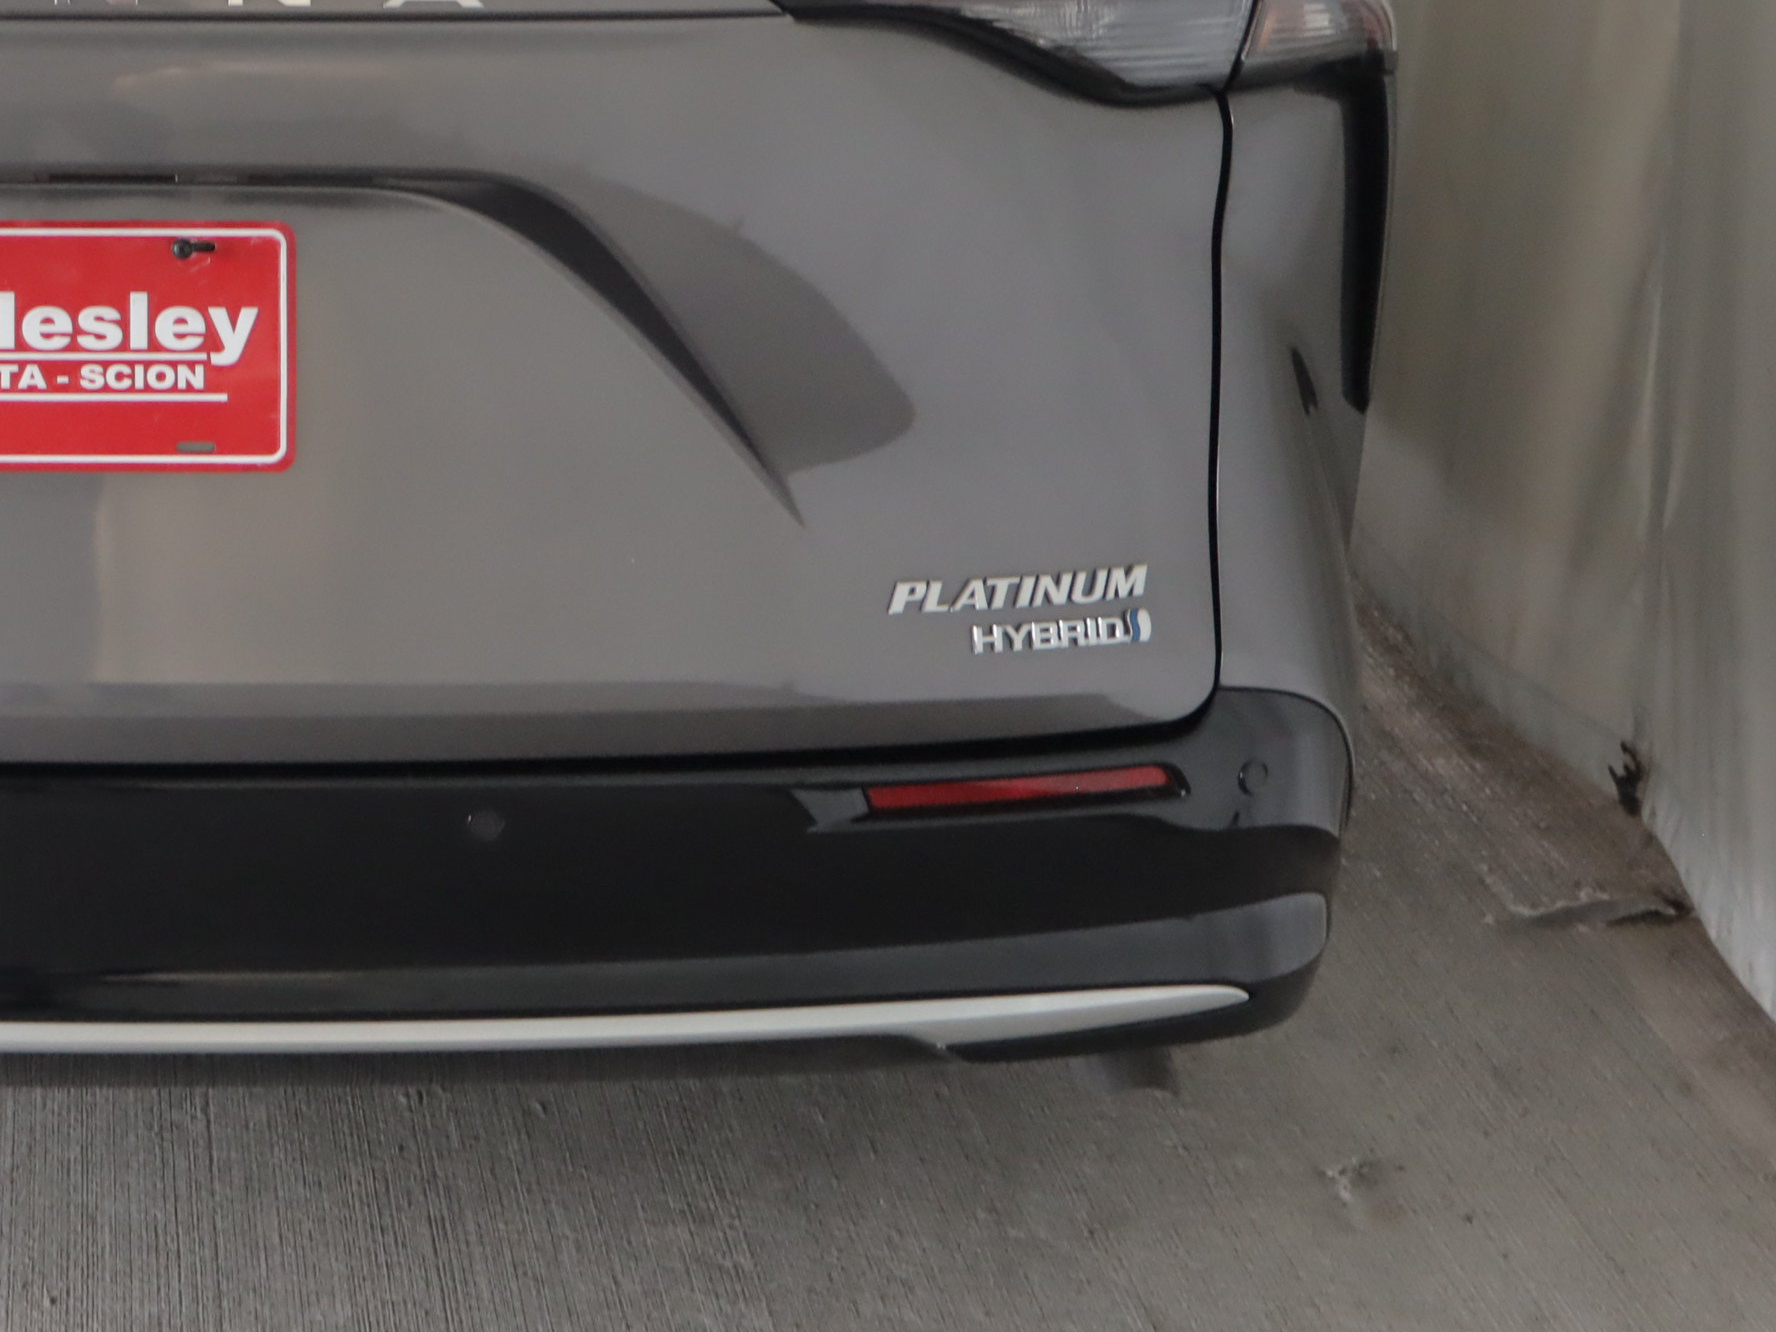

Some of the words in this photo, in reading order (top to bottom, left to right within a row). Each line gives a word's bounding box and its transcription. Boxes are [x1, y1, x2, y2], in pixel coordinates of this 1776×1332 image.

[79, 363, 205, 391] SCION
[887, 563, 1149, 615] PLATINUM
[971, 615, 1126, 655] HYBRID
